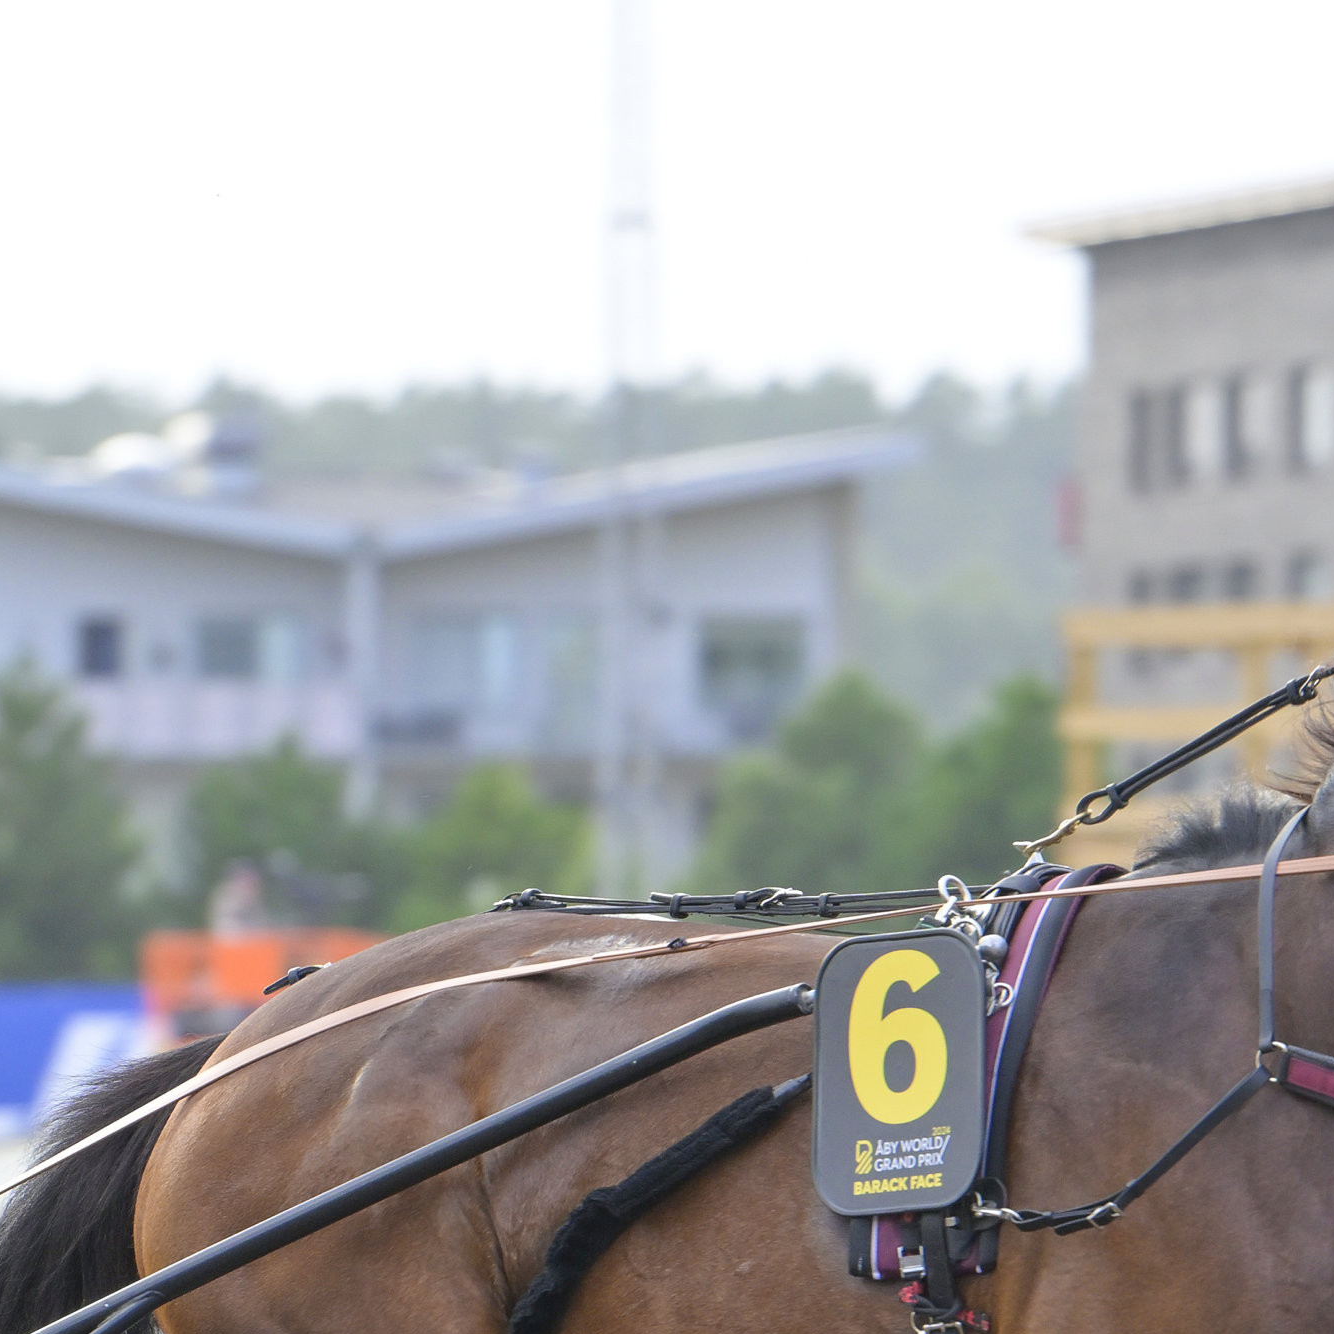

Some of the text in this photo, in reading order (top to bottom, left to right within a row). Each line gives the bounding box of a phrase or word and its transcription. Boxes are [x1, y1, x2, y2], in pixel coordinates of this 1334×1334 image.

[848, 949, 948, 1125] 6
[875, 1136, 944, 1156] ÅBY WORLD
[874, 1152, 944, 1172] GRAND PRIX
[853, 1172, 943, 1196] BARACK FACE
